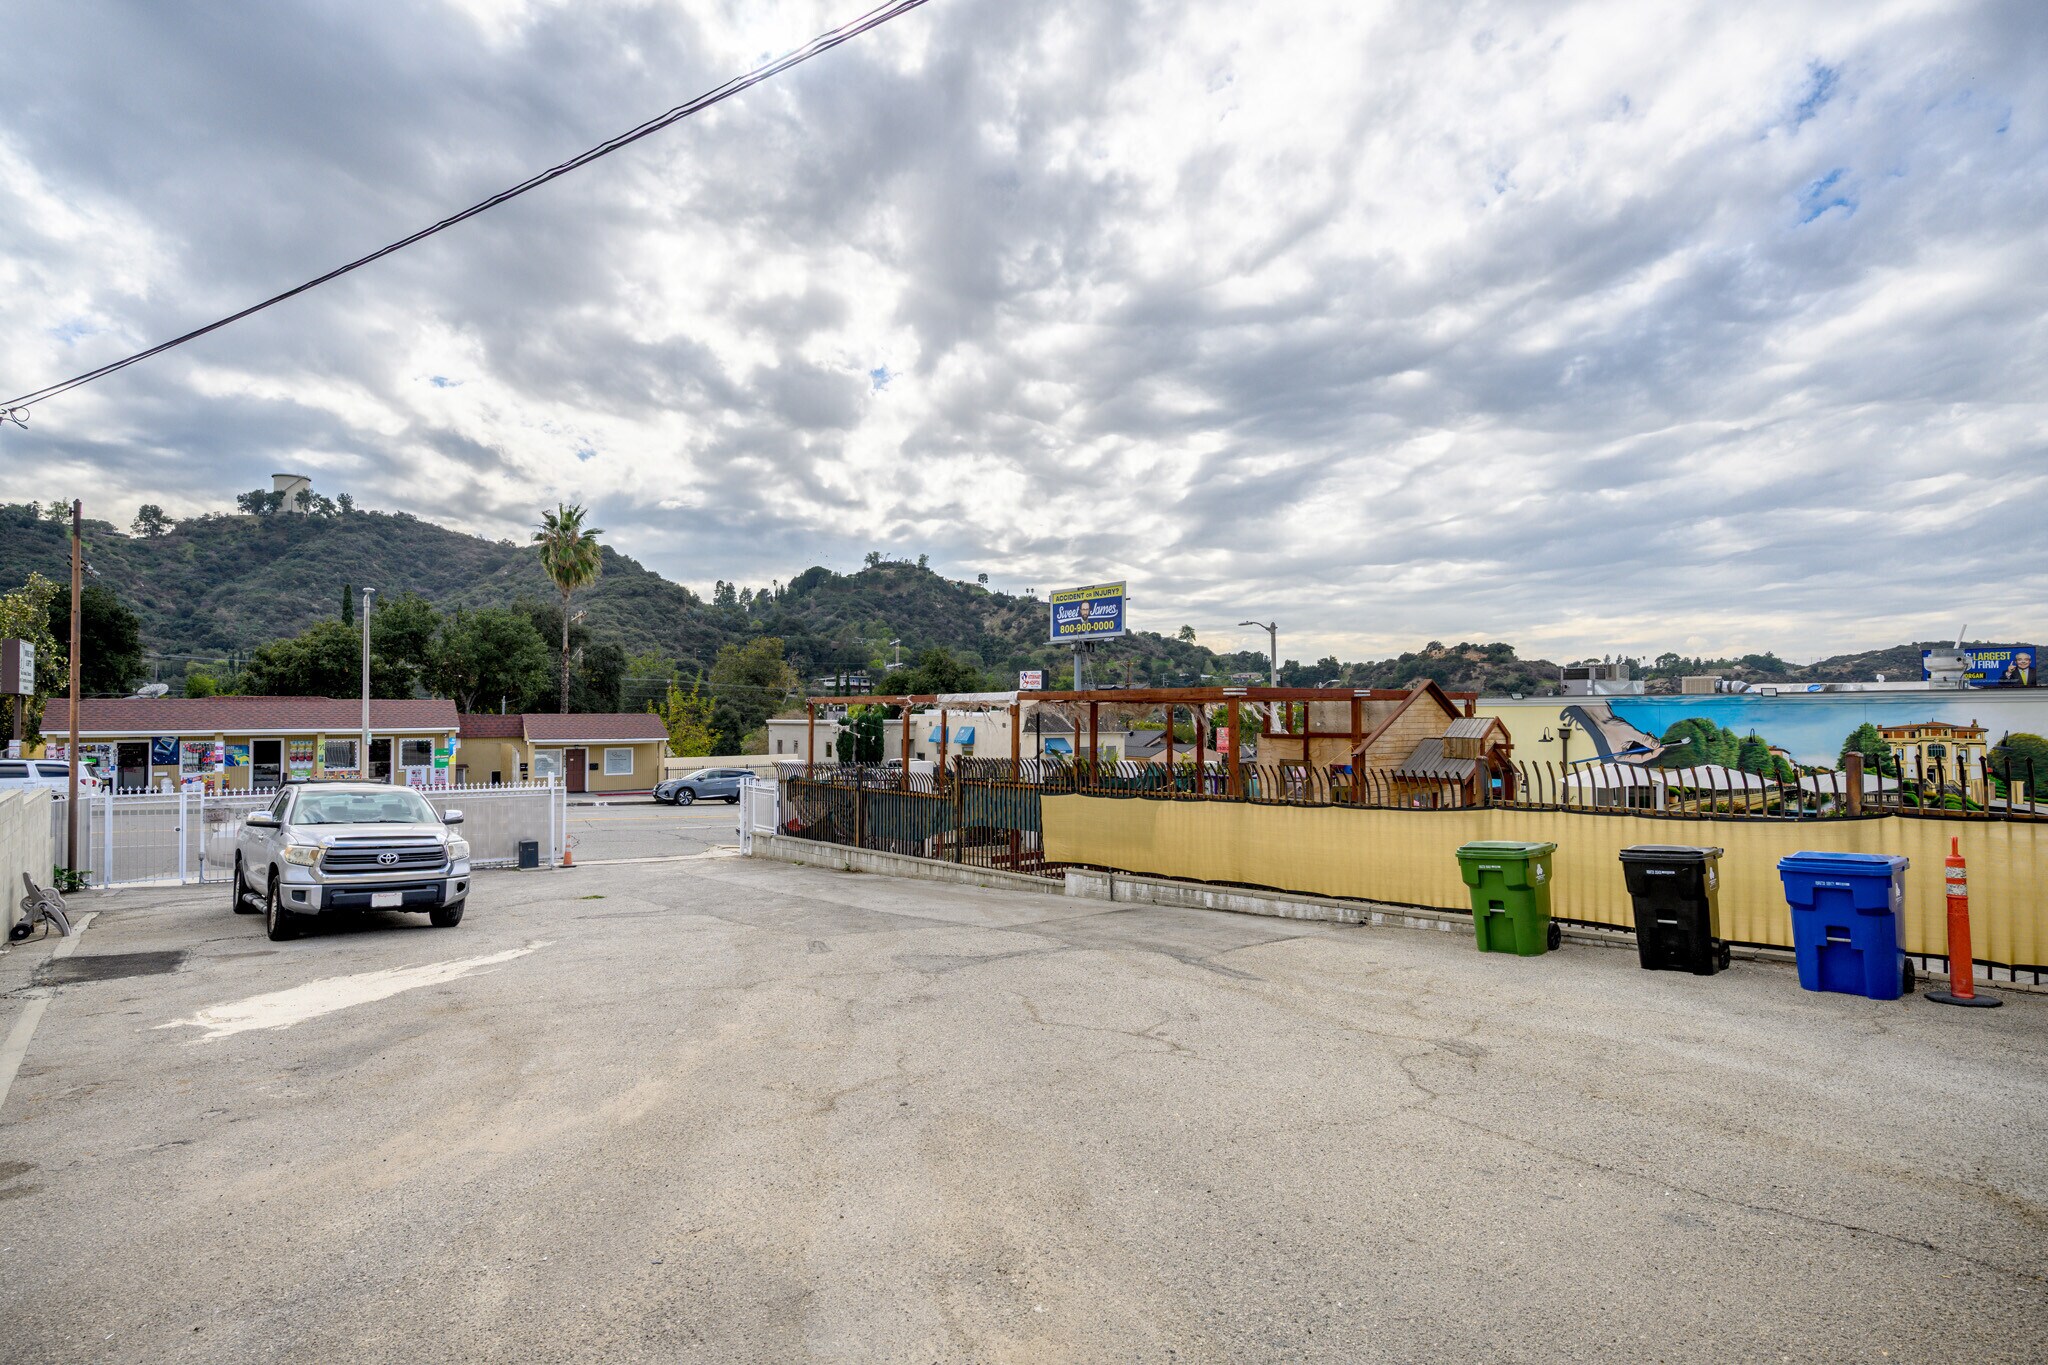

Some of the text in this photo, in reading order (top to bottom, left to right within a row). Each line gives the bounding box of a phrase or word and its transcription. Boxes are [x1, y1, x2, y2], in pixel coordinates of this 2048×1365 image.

[1056, 593, 1084, 602] ACCIDENT
[1093, 588, 1119, 597] INJURY?
[1057, 603, 1117, 619] Sweet James
[1060, 621, 1114, 633] 800-900-0000
[1973, 652, 2011, 660] LARGEST
[1978, 661, 1999, 669] FIRM
